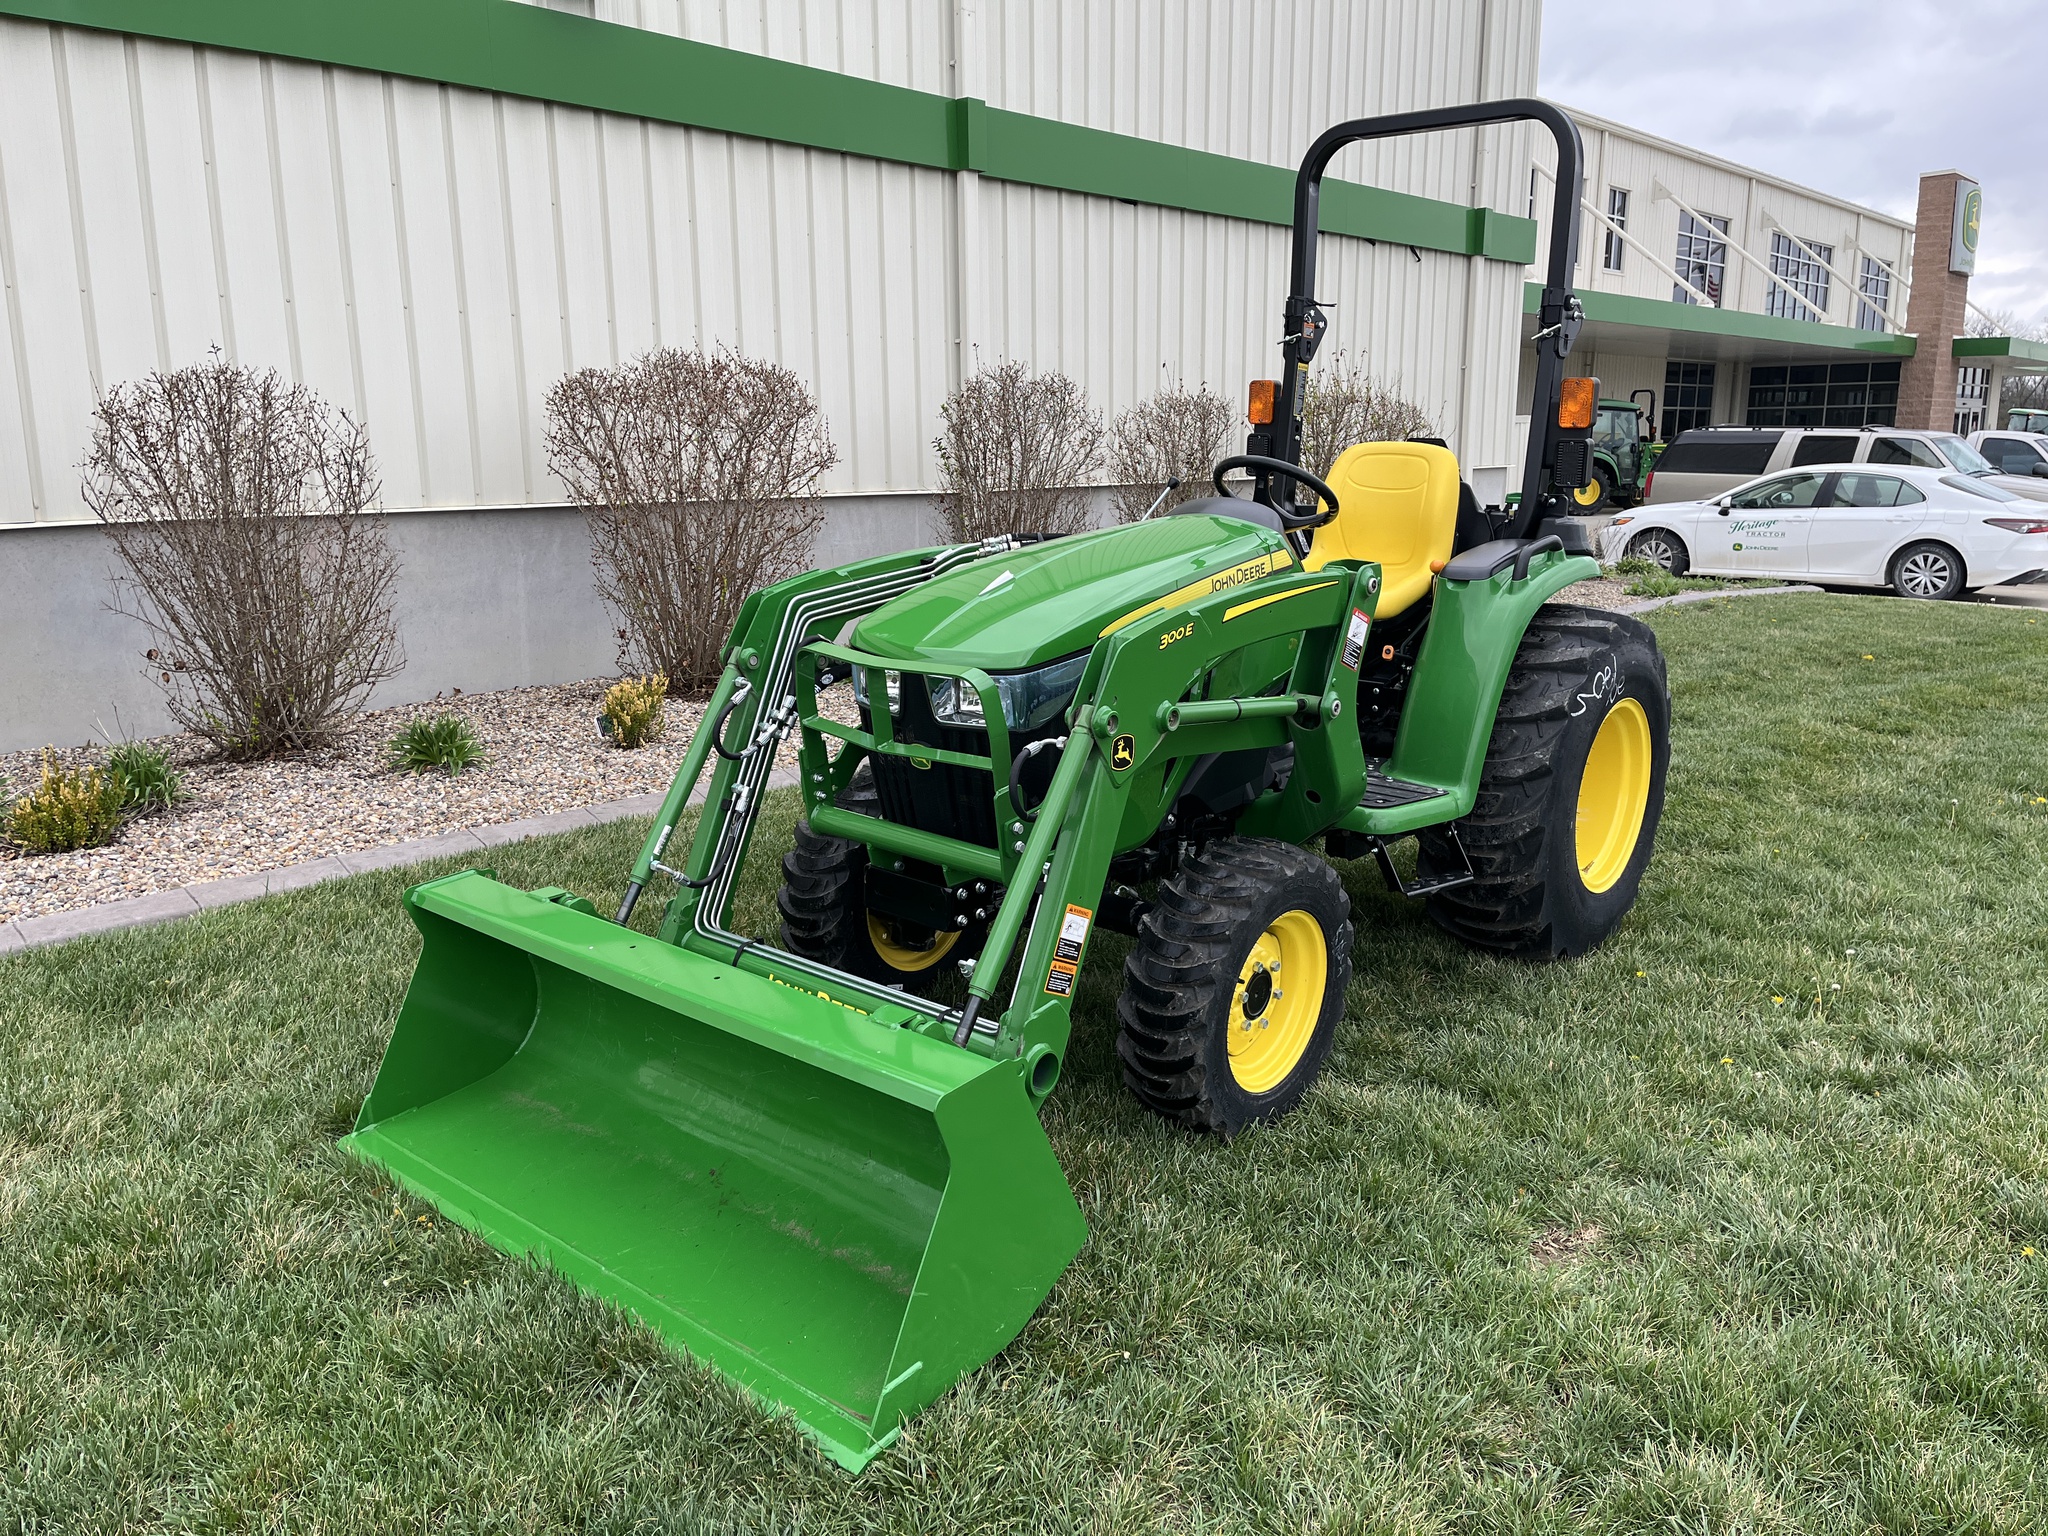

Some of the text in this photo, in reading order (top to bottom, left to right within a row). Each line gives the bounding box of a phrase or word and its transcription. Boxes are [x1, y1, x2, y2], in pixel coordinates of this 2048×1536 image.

[1728, 520, 1779, 534] Heritage
[1209, 562, 1266, 594] JOHN DEERE
[1283, 877, 1338, 906] GALAXY
